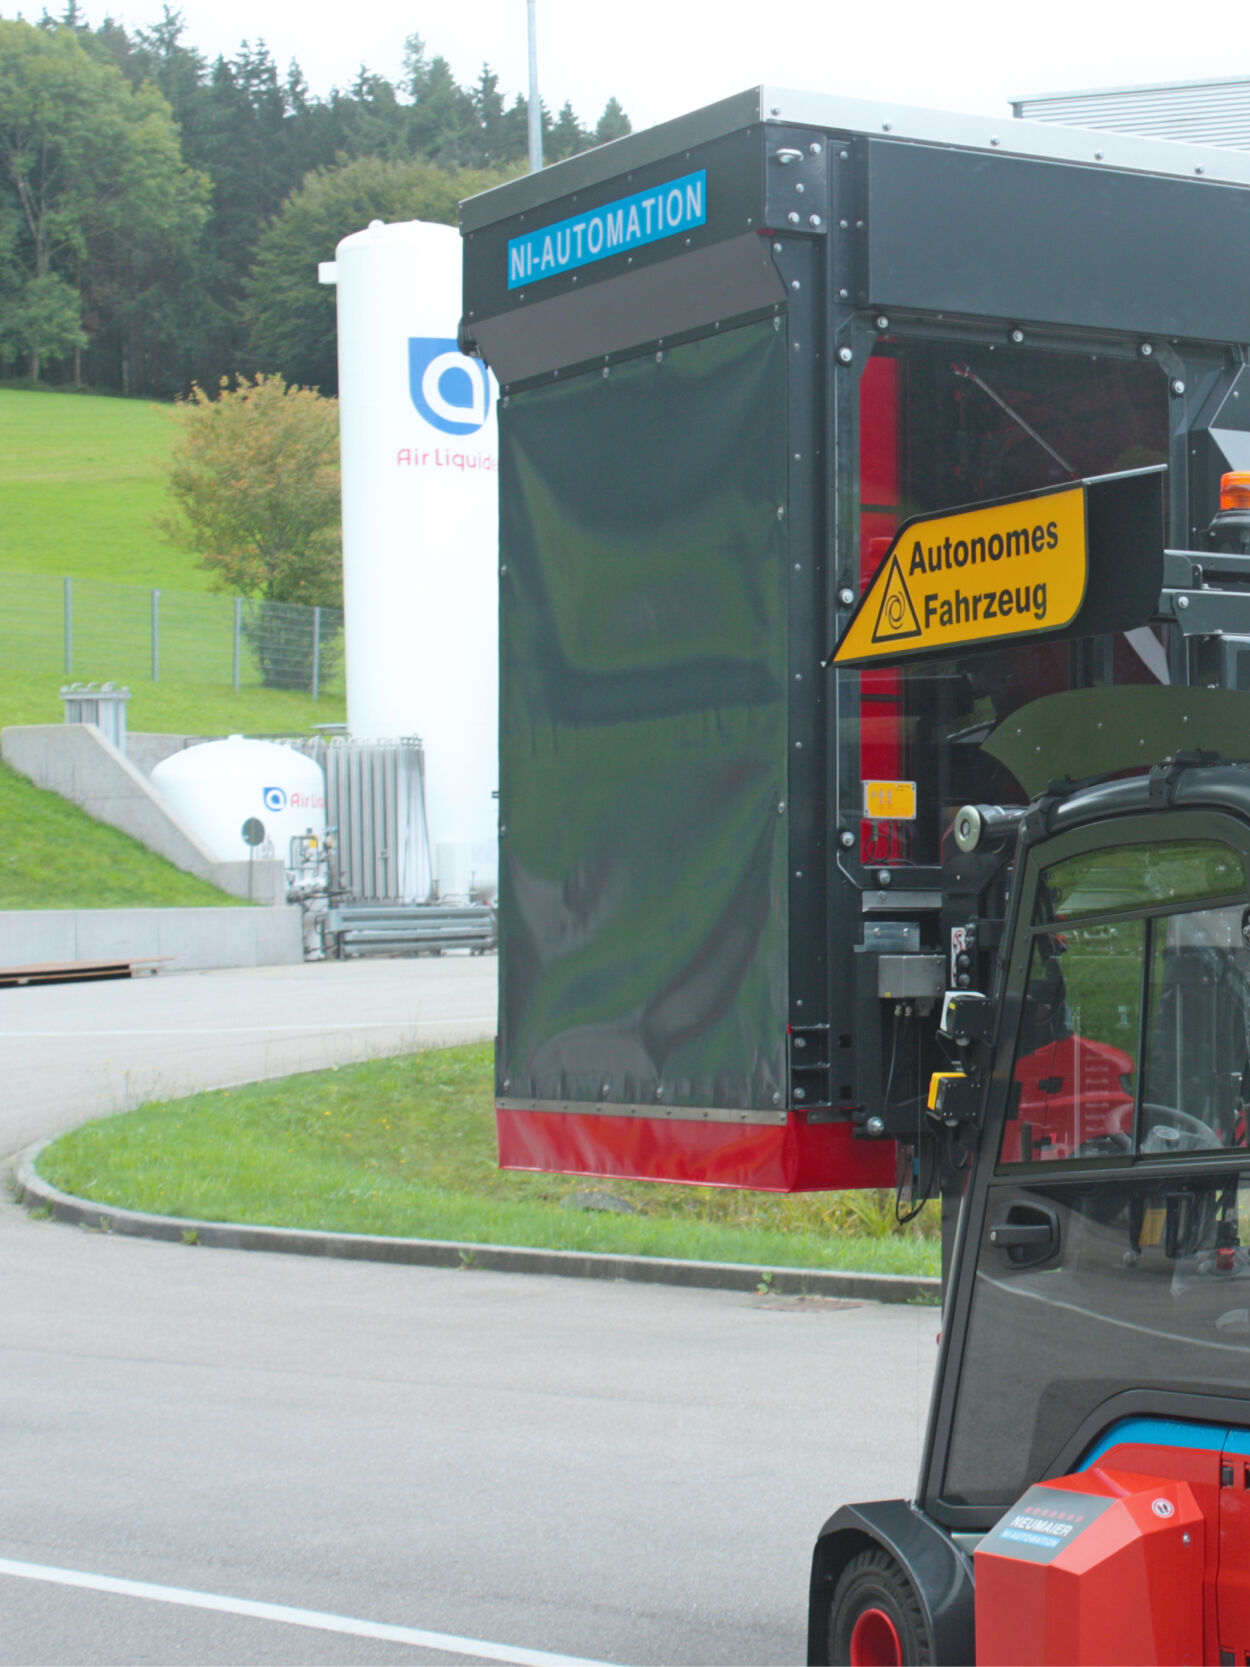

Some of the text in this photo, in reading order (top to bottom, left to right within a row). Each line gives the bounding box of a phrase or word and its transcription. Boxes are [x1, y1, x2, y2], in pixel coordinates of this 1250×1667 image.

[510, 180, 702, 281] NI-AUTOMATION
[397, 448, 429, 467] Air
[908, 521, 1059, 577] Autonomes
[923, 582, 1048, 630] Fahrzeug
[290, 792, 309, 809] Air
[1009, 1515, 1074, 1537] NEUMAIER
